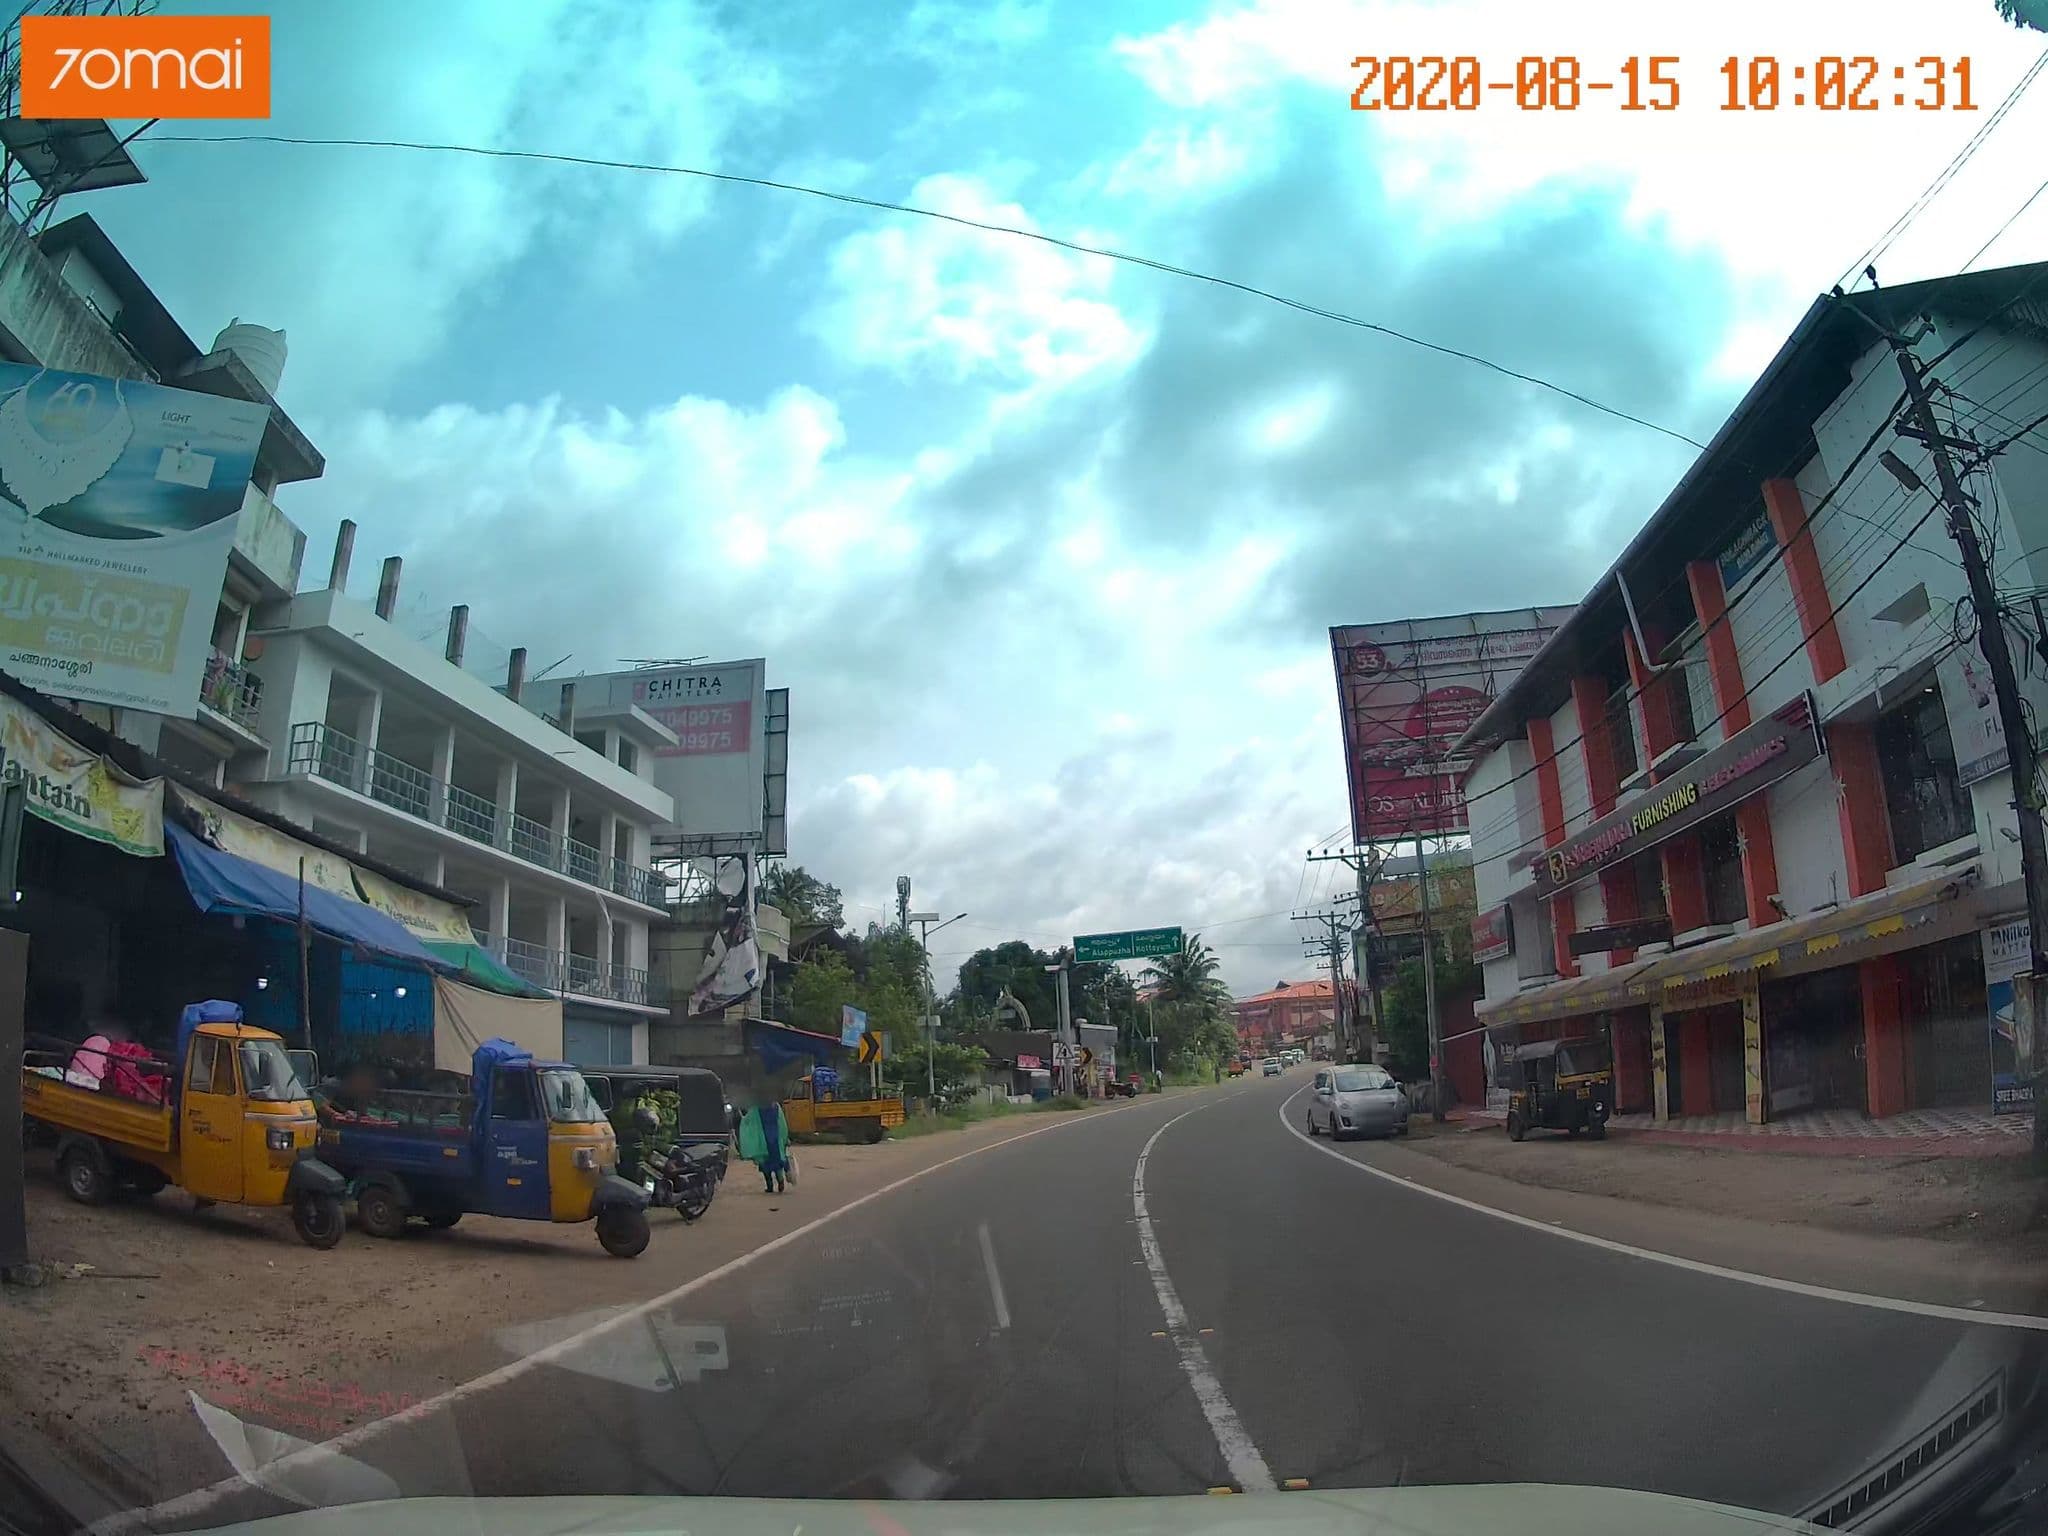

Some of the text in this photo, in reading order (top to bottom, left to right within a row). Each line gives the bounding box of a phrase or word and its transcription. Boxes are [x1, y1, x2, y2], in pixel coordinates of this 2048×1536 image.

[160, 410, 192, 424] LIGHT
[47, 551, 101, 567] HALLMARKED
[102, 561, 149, 575] JEWELLERY
[648, 676, 722, 692] CHITRA
[648, 689, 721, 700] PAINTERS
[3, 758, 92, 819] antain
[1631, 782, 1697, 836] FURNISHING
[2001, 925, 2029, 944] Nilka
